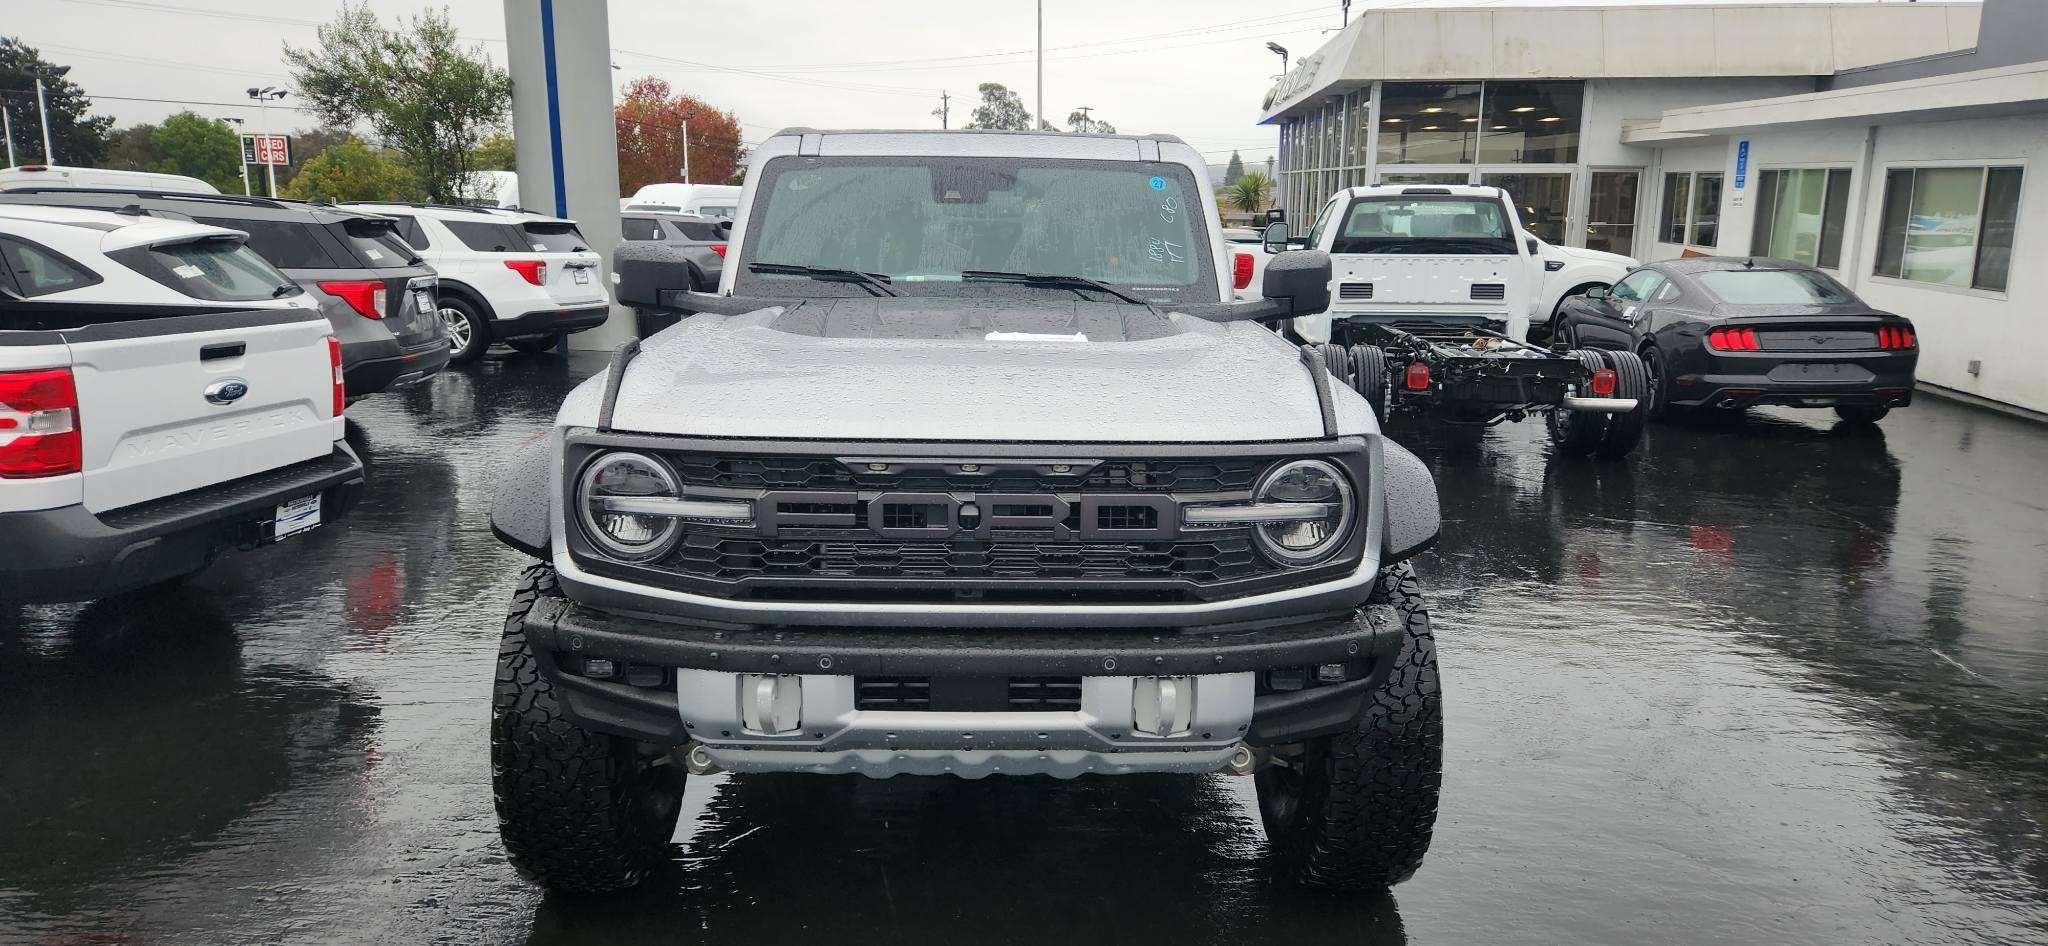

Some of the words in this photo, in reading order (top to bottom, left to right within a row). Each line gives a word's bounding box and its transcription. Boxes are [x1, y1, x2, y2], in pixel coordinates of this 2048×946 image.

[259, 139, 283, 150] UED
[261, 150, 285, 161] CRS
[757, 491, 1177, 541] FORD
